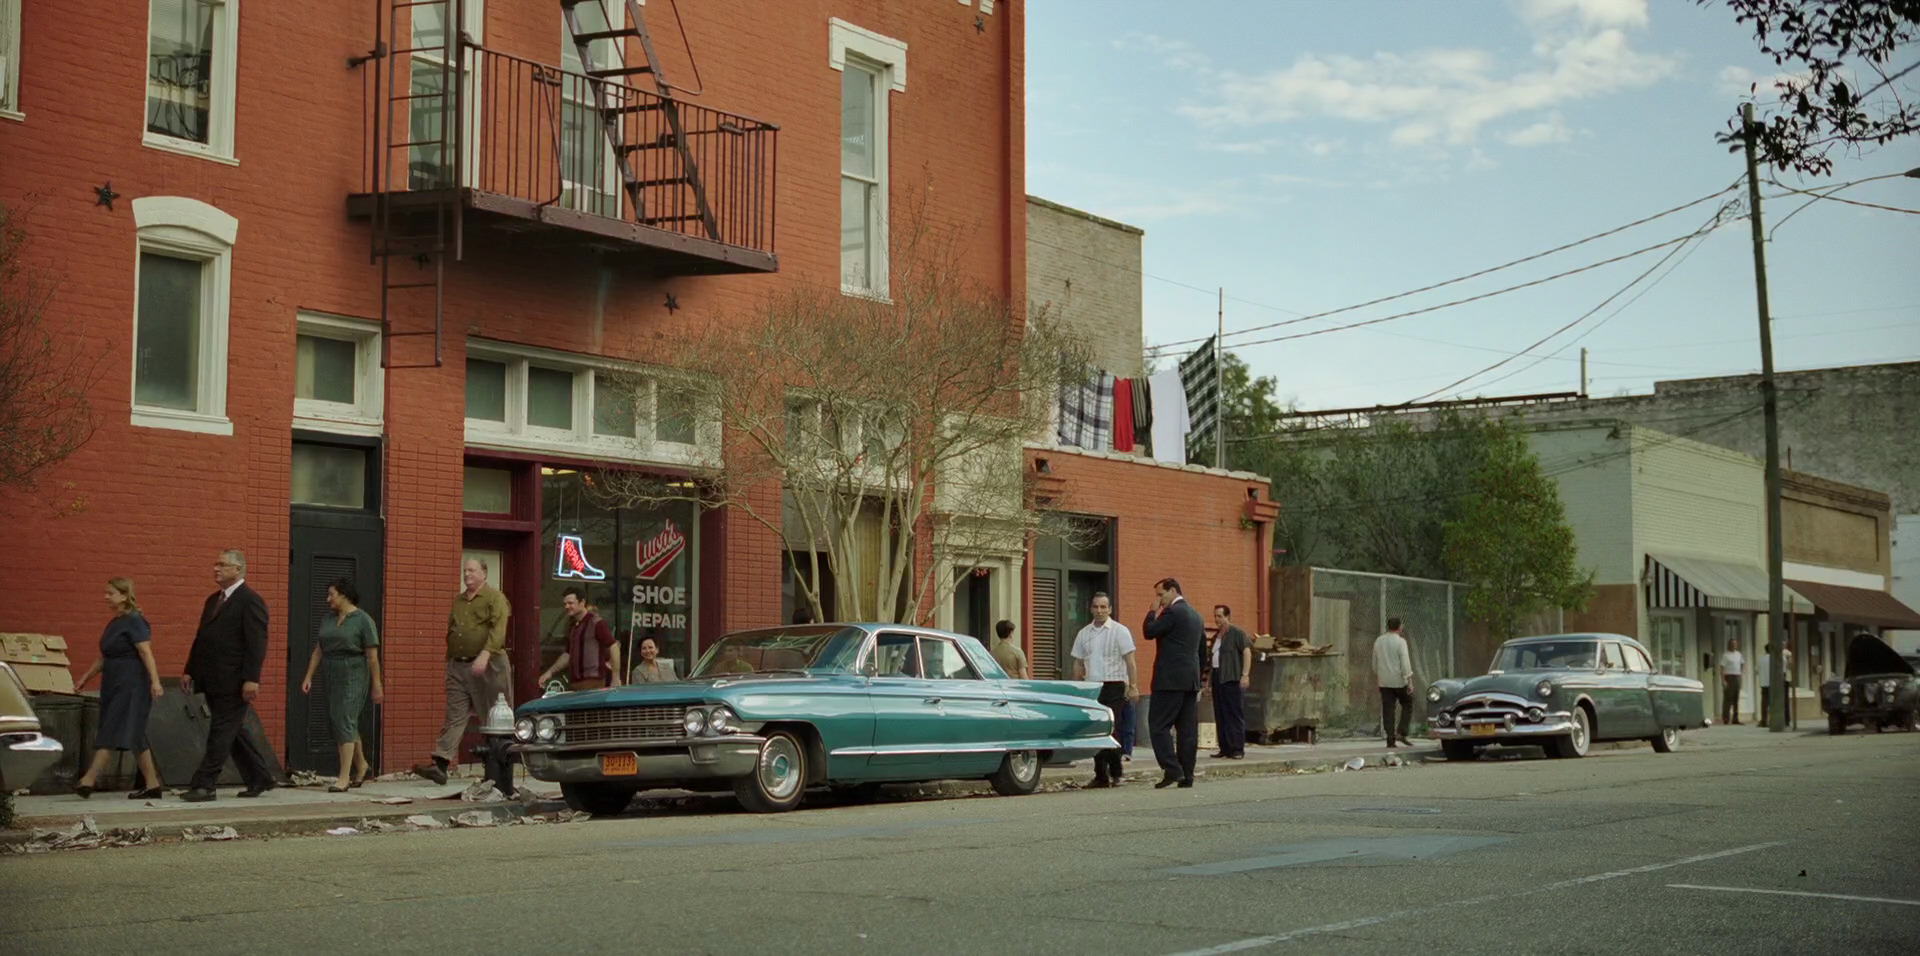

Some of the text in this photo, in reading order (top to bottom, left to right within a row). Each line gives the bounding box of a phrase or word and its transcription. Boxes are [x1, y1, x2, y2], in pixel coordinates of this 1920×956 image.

[636, 518, 685, 570] Luca's
[632, 585, 686, 605] SHOE
[632, 612, 686, 629] REPAIR
